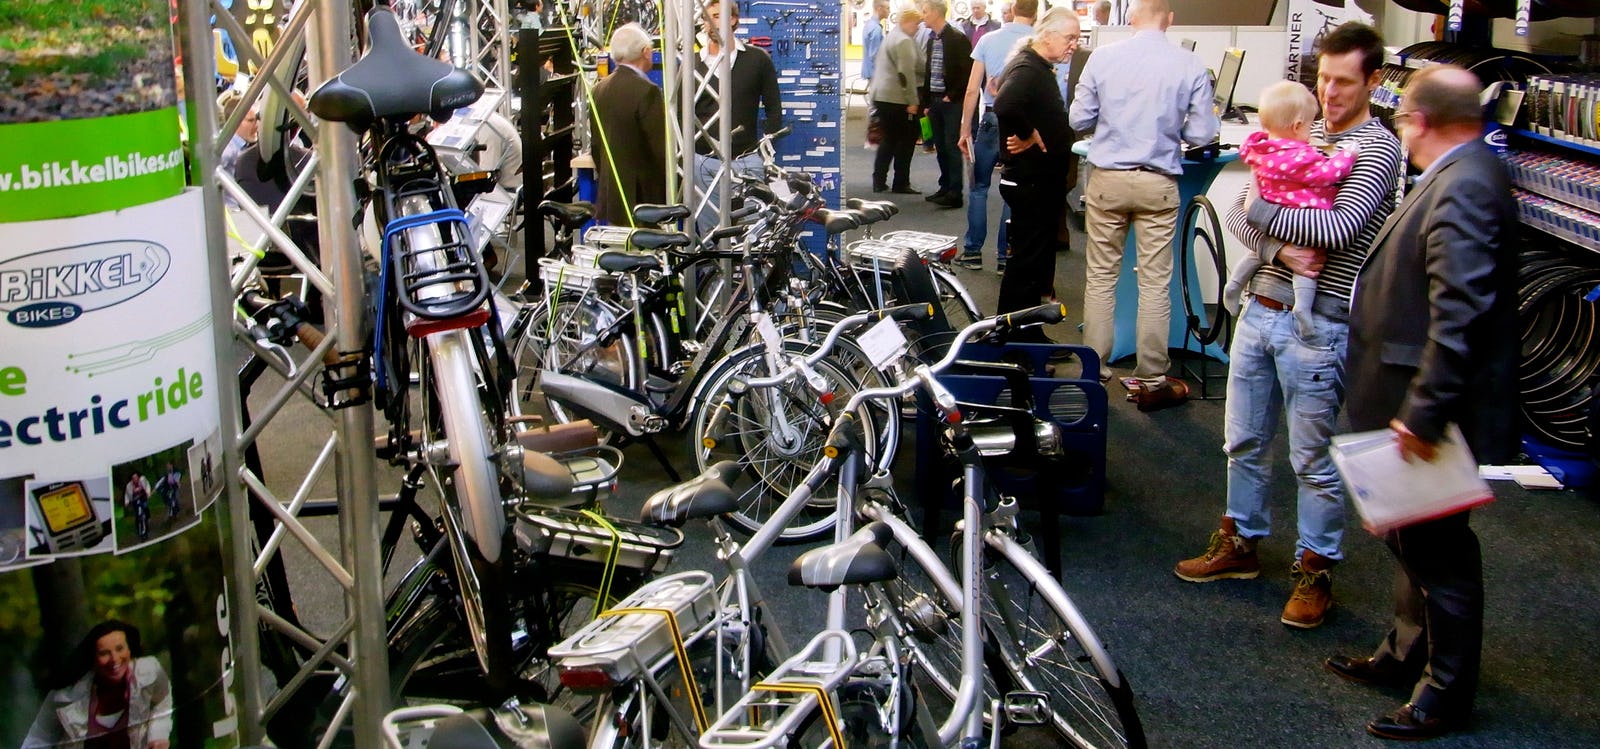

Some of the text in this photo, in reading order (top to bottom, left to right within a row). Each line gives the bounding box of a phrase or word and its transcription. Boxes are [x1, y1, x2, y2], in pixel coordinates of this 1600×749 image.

[1287, 12, 1303, 82] PARTNER
[15, 306, 75, 324] BIKES
[137, 367, 204, 422] ride
